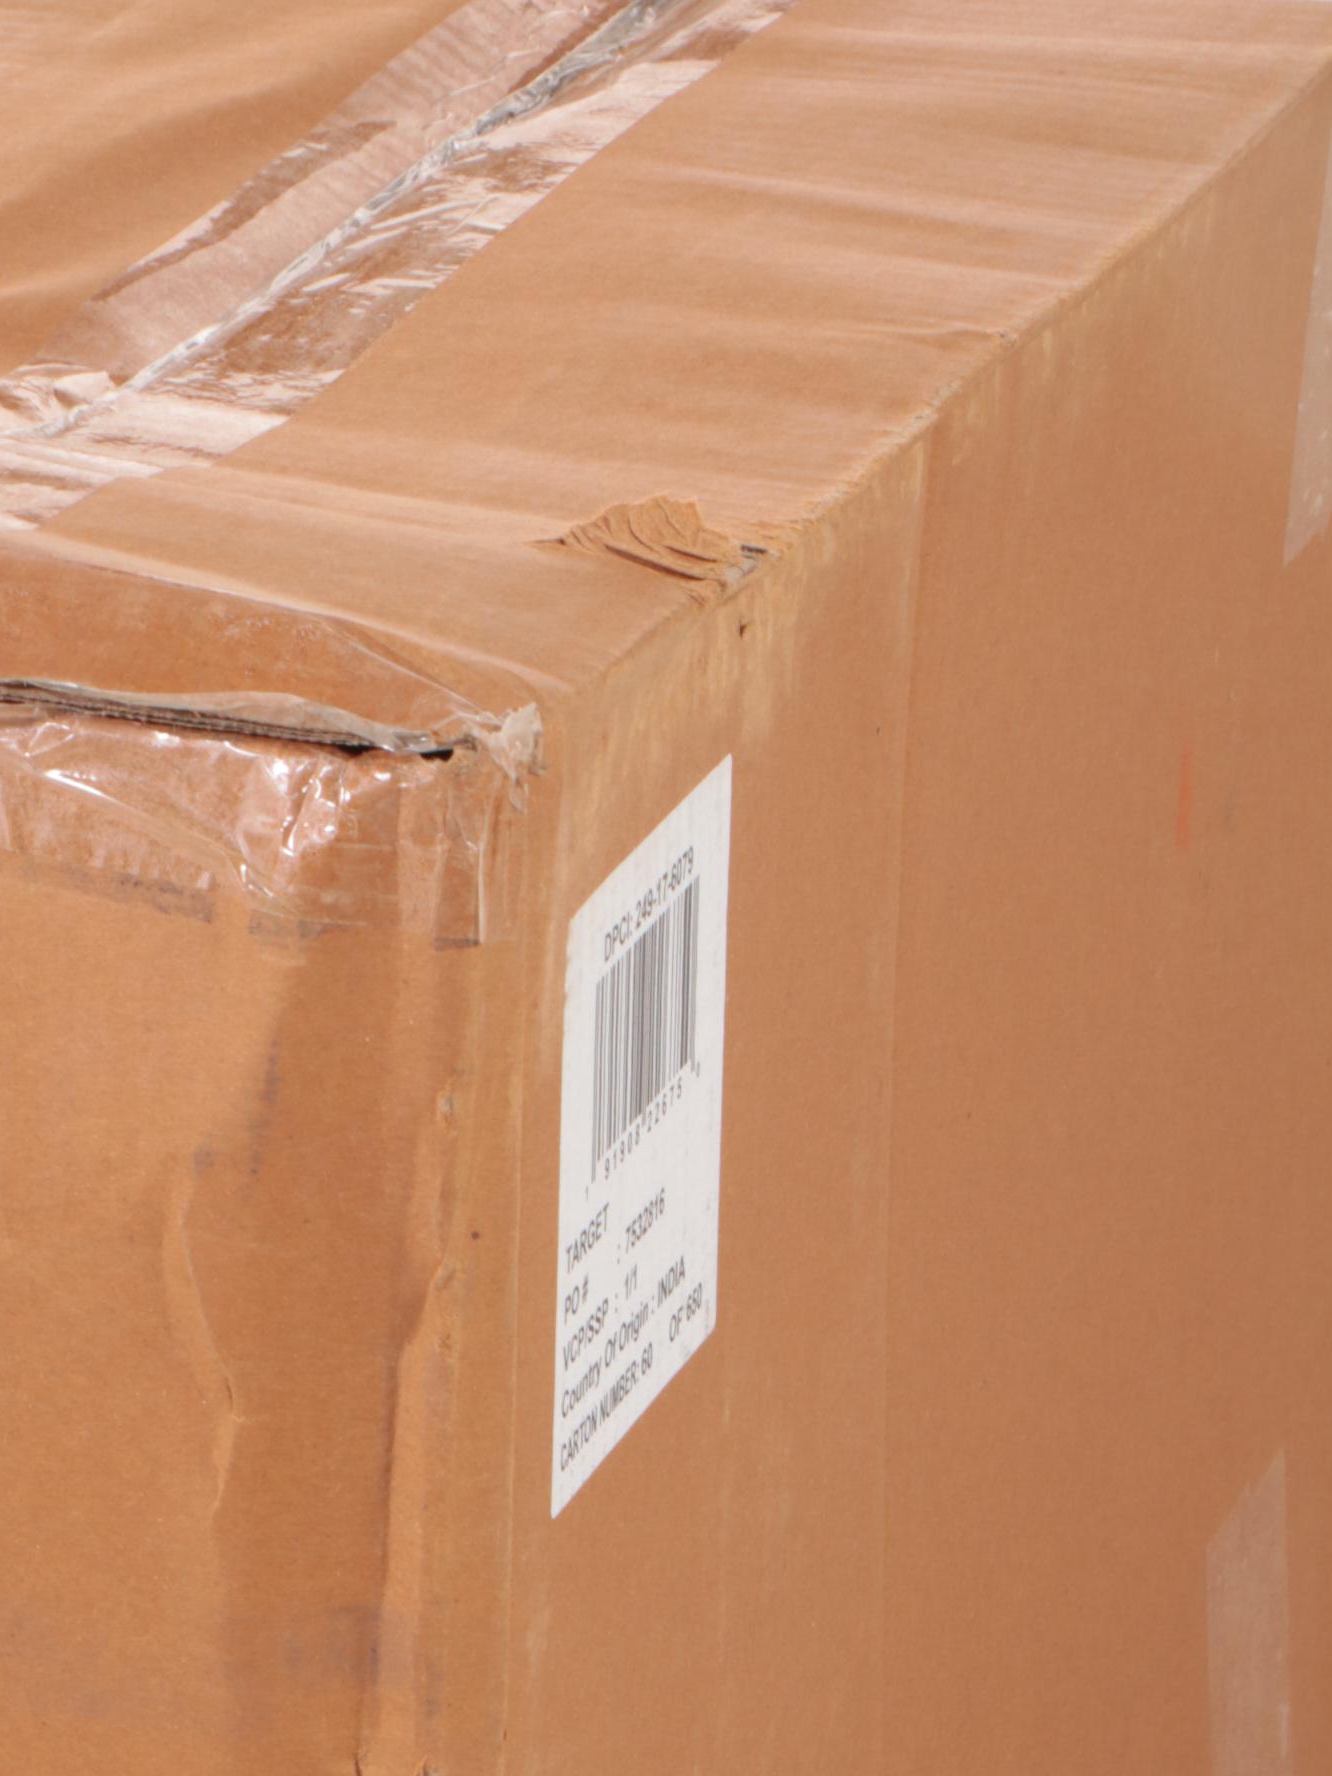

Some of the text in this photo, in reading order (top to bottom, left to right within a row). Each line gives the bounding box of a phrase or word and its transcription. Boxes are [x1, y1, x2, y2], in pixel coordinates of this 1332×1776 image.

[604, 845, 694, 963] DPCI: 249-17-6079
[604, 1125, 640, 1178] 91908
[647, 1076, 683, 1133] 22675
[564, 1285, 579, 1325] PO
[624, 1188, 665, 1254] 7532816
[566, 1203, 609, 1274] TARGET
[561, 1354, 600, 1419] Country
[604, 1330, 616, 1369] Of
[618, 1301, 648, 1352] Origin
[657, 1255, 685, 1305] INDIA
[563, 1297, 608, 1372] VCP/SSP
[624, 1264, 637, 1301] 1/1
[560, 1407, 597, 1472] CARTON
[599, 1360, 640, 1422] NUMBER:
[669, 1305, 682, 1344] OF
